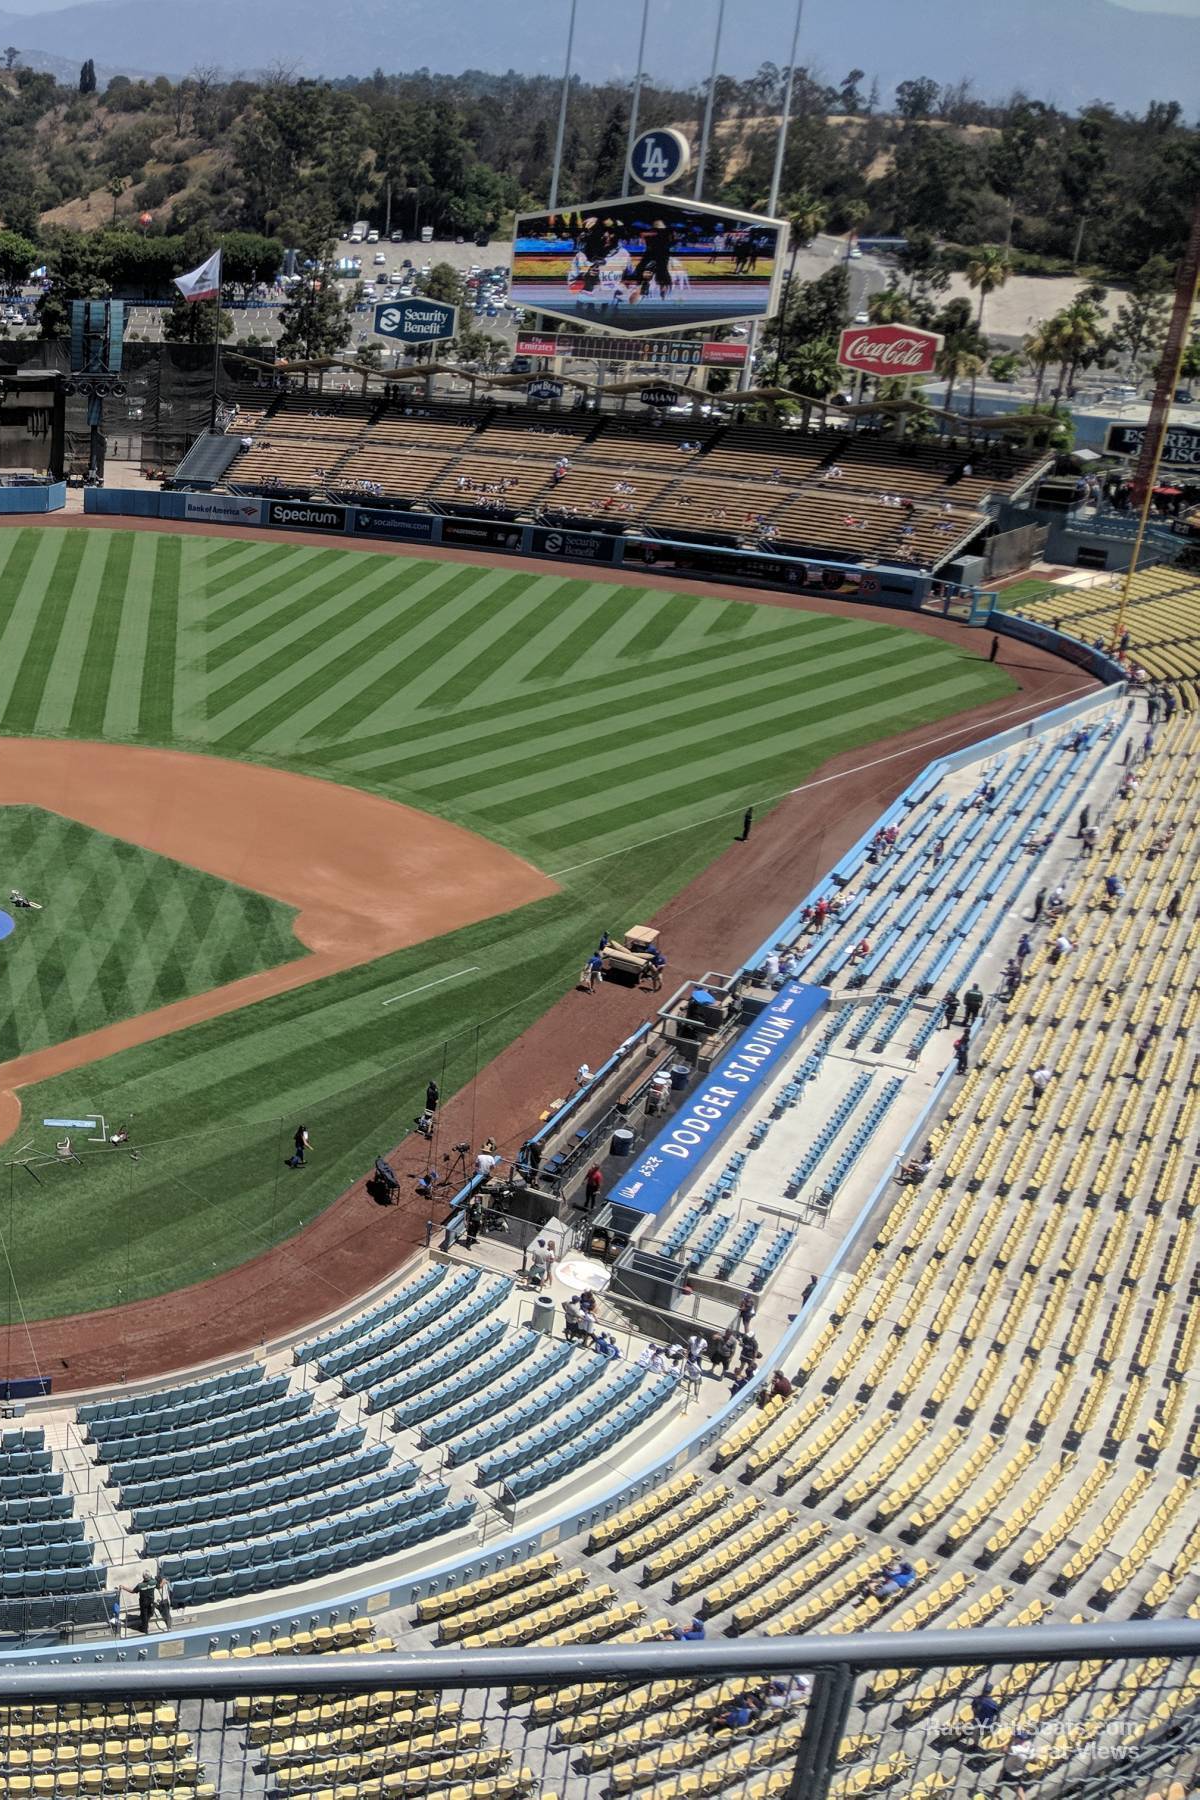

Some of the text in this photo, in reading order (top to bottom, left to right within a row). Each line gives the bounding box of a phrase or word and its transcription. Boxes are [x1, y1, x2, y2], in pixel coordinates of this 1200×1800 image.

[642, 138, 669, 177] LA
[404, 308, 448, 324] Security
[403, 321, 441, 334] Benefit
[519, 342, 553, 352] Emirates
[671, 349, 700, 363] 0 0 0
[529, 381, 561, 395] JIM BEAM
[642, 392, 677, 402] DASANI
[272, 506, 337, 523] Spectrum
[565, 535, 600, 547] Security
[564, 545, 595, 557] Benefit
[863, 580, 876, 590] 76
[660, 1014, 796, 1159] DODGER STADIUM
[638, 1156, 663, 1177] ようこそ
